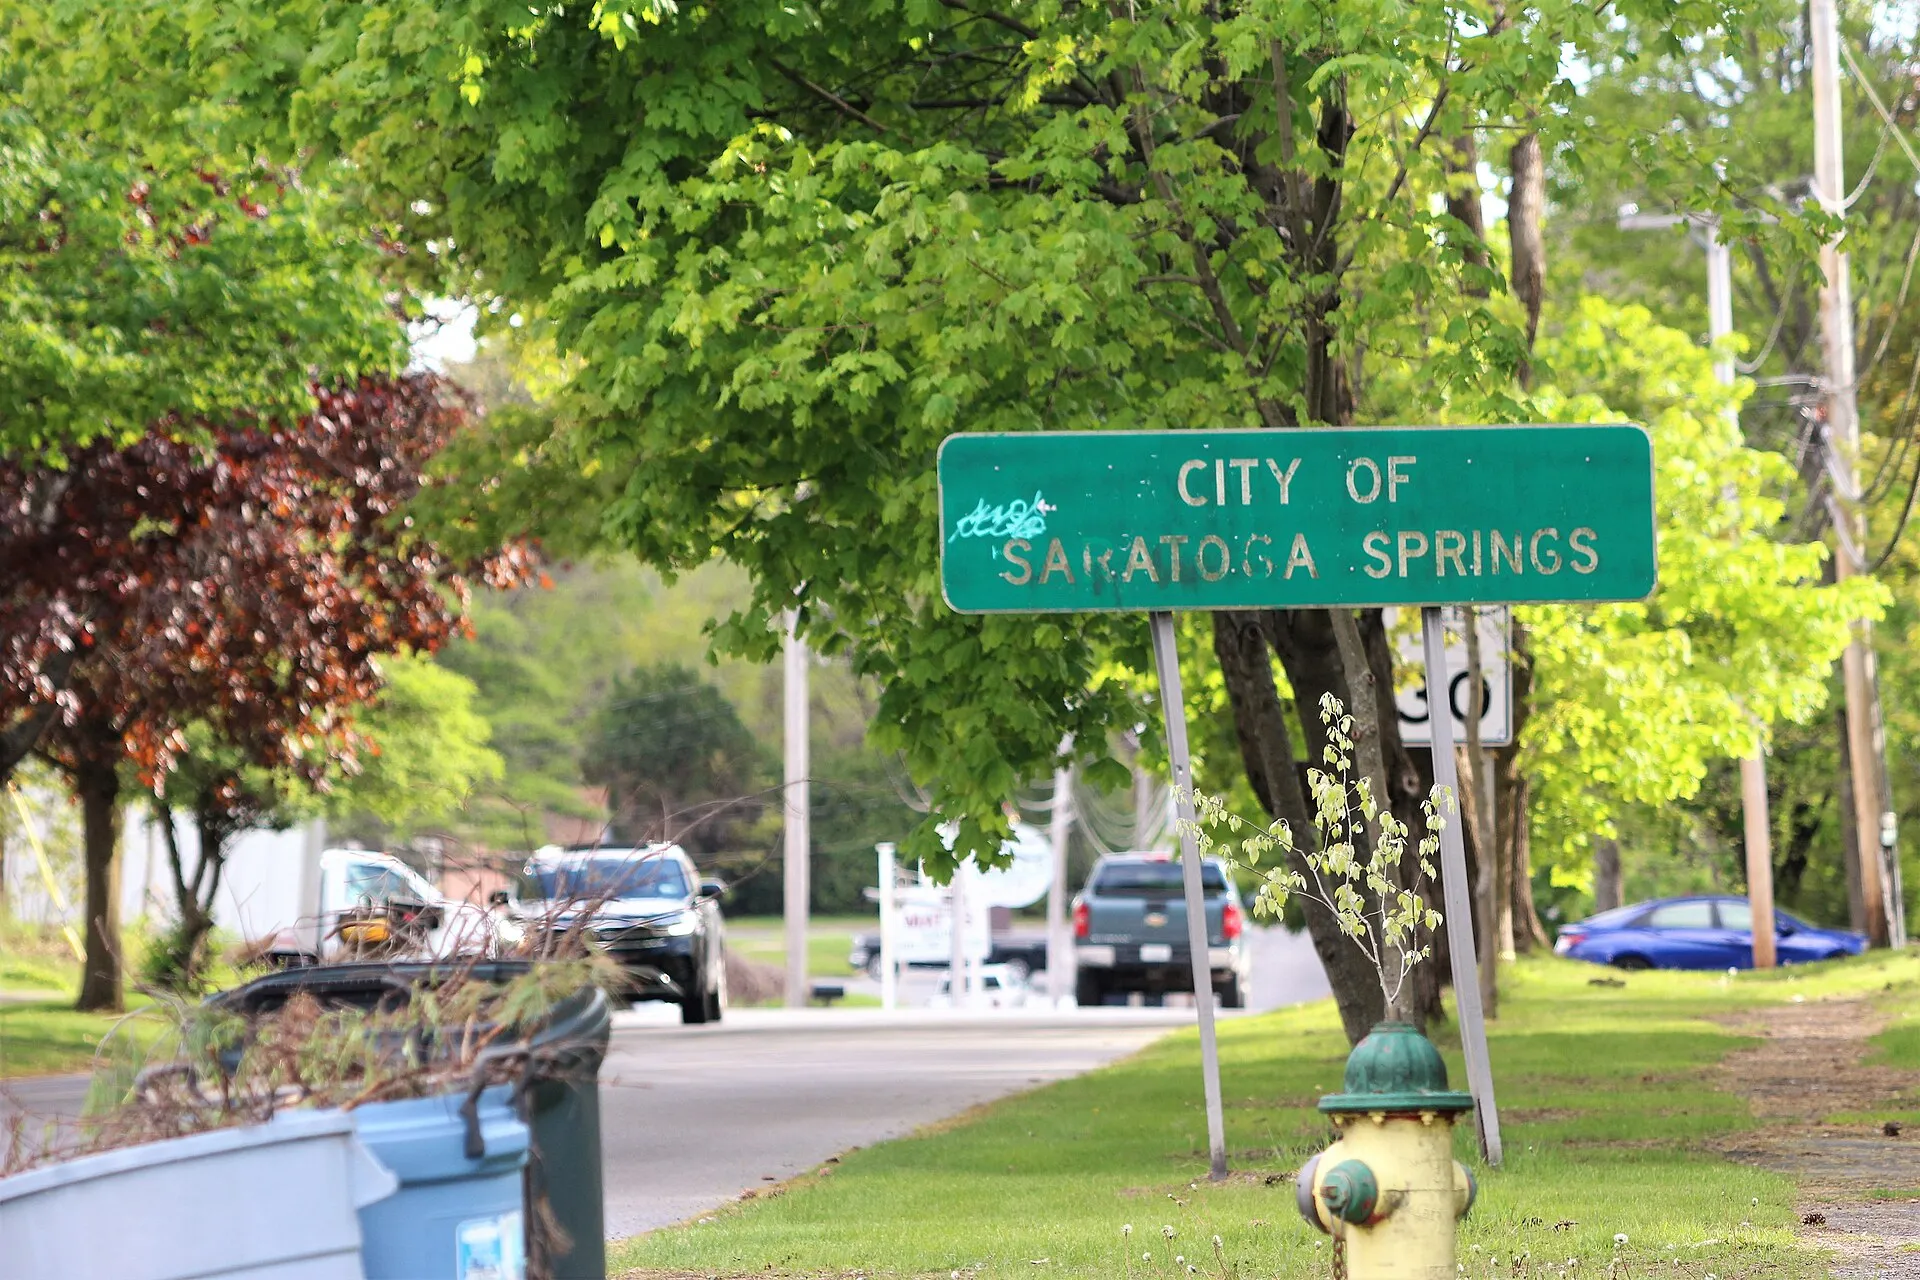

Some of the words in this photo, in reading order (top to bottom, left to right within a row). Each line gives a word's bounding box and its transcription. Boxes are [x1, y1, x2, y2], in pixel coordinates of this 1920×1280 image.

[1177, 458, 1302, 506] CITY
[1346, 456, 1417, 504] OF
[1002, 532, 1320, 585] SARATOGA
[1362, 527, 1599, 579] SPRINGS
